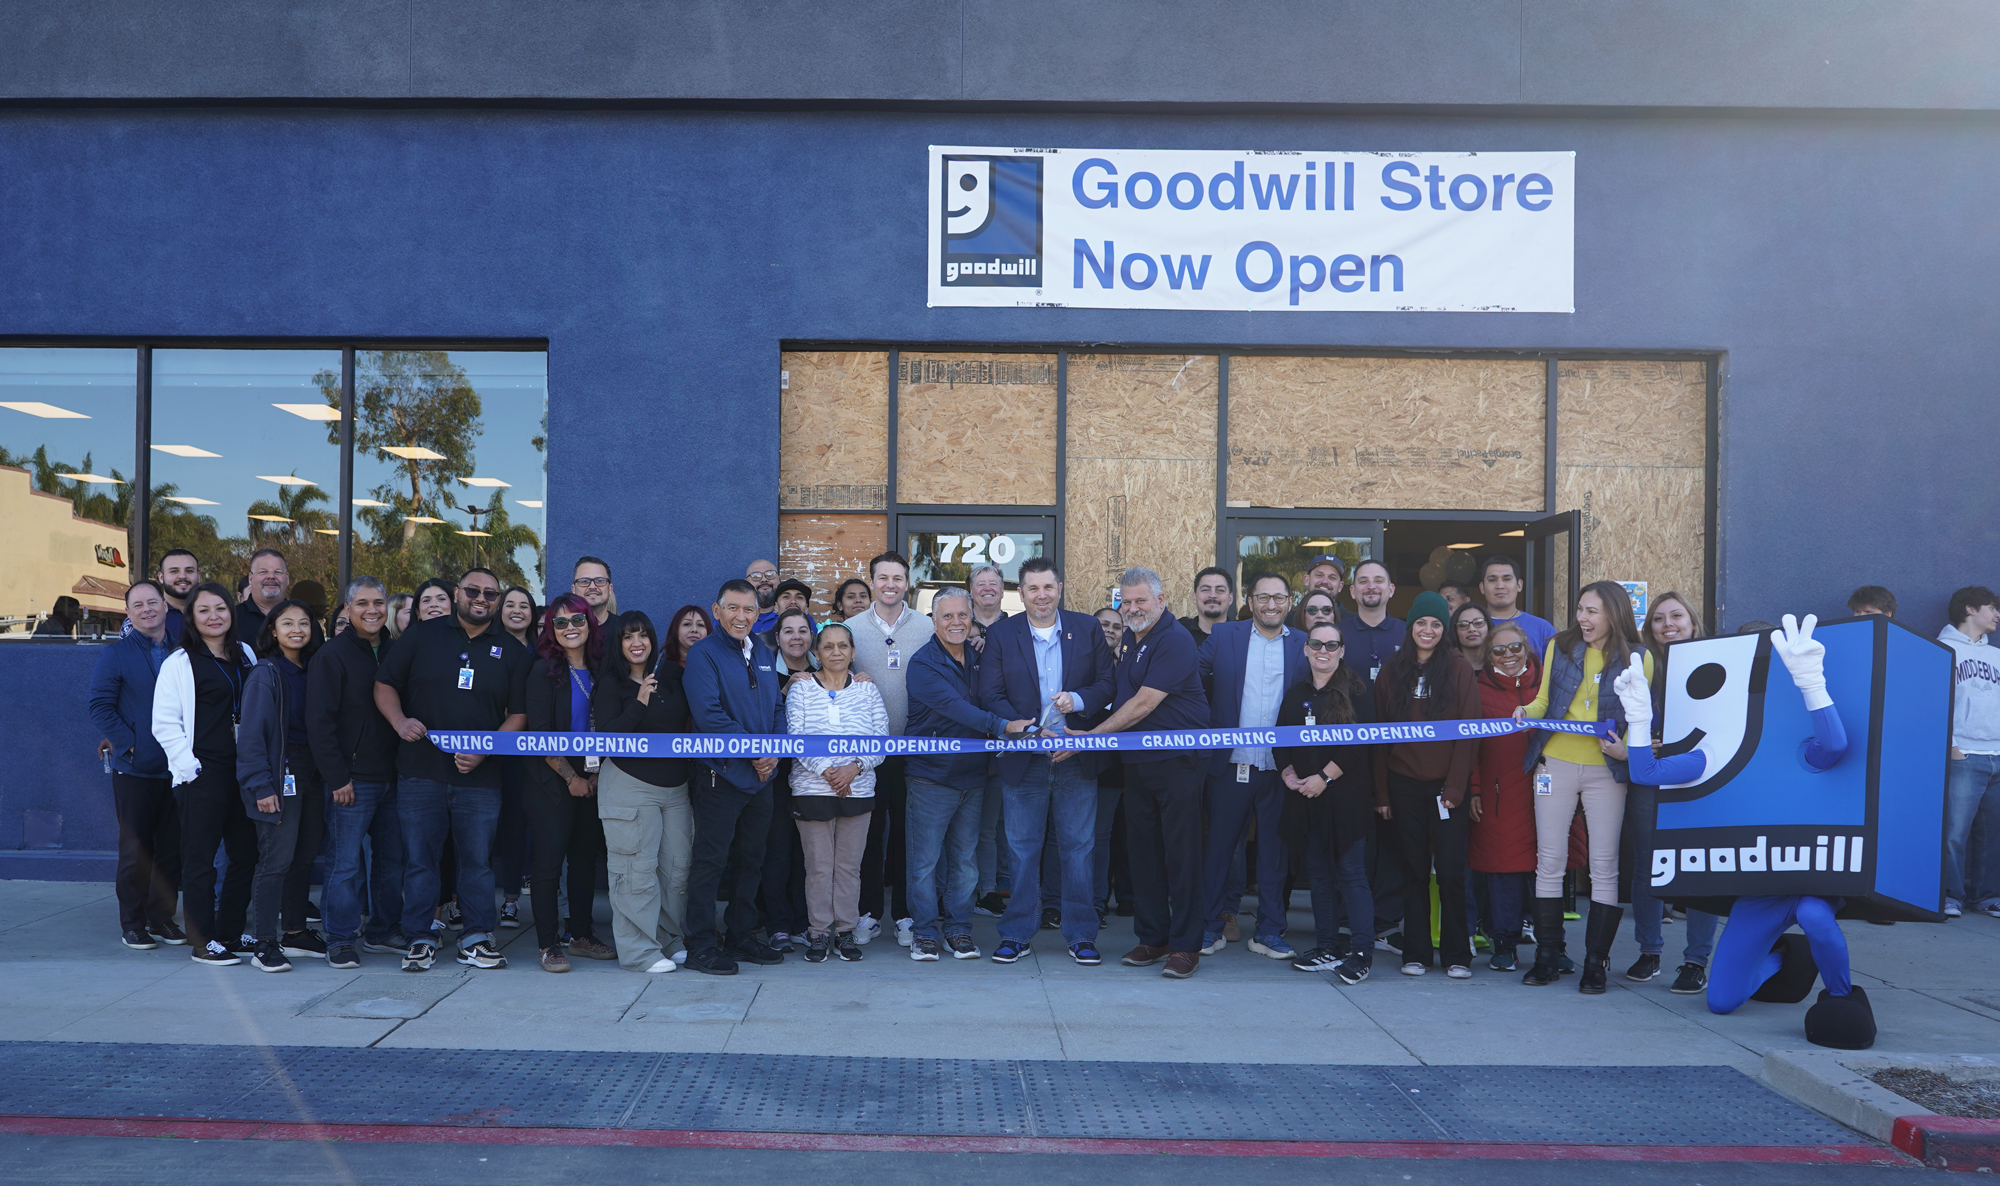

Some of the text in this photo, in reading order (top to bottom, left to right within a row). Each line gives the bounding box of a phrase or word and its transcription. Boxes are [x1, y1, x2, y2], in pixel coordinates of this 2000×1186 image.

[1072, 157, 1554, 212] Goodwill Store
[946, 258, 1037, 282] goodwill
[1072, 238, 1404, 306] Now Open
[936, 535, 1016, 564] 720
[516, 735, 569, 752] GRAND
[572, 736, 649, 753] OPENING
[671, 737, 725, 754] GRAND
[728, 738, 805, 754] OPENING
[827, 738, 881, 754] GRAND
[884, 739, 961, 753] OPENING
[984, 739, 1038, 750] GRAND
[1041, 736, 1119, 749] OPENING
[1141, 734, 1196, 748] GRAND
[1198, 731, 1277, 747] OPENING
[1299, 728, 1354, 743] GRAND
[1356, 725, 1436, 741] OPENING
[1458, 721, 1513, 736] GRAND
[1651, 835, 1864, 886] goodwill
